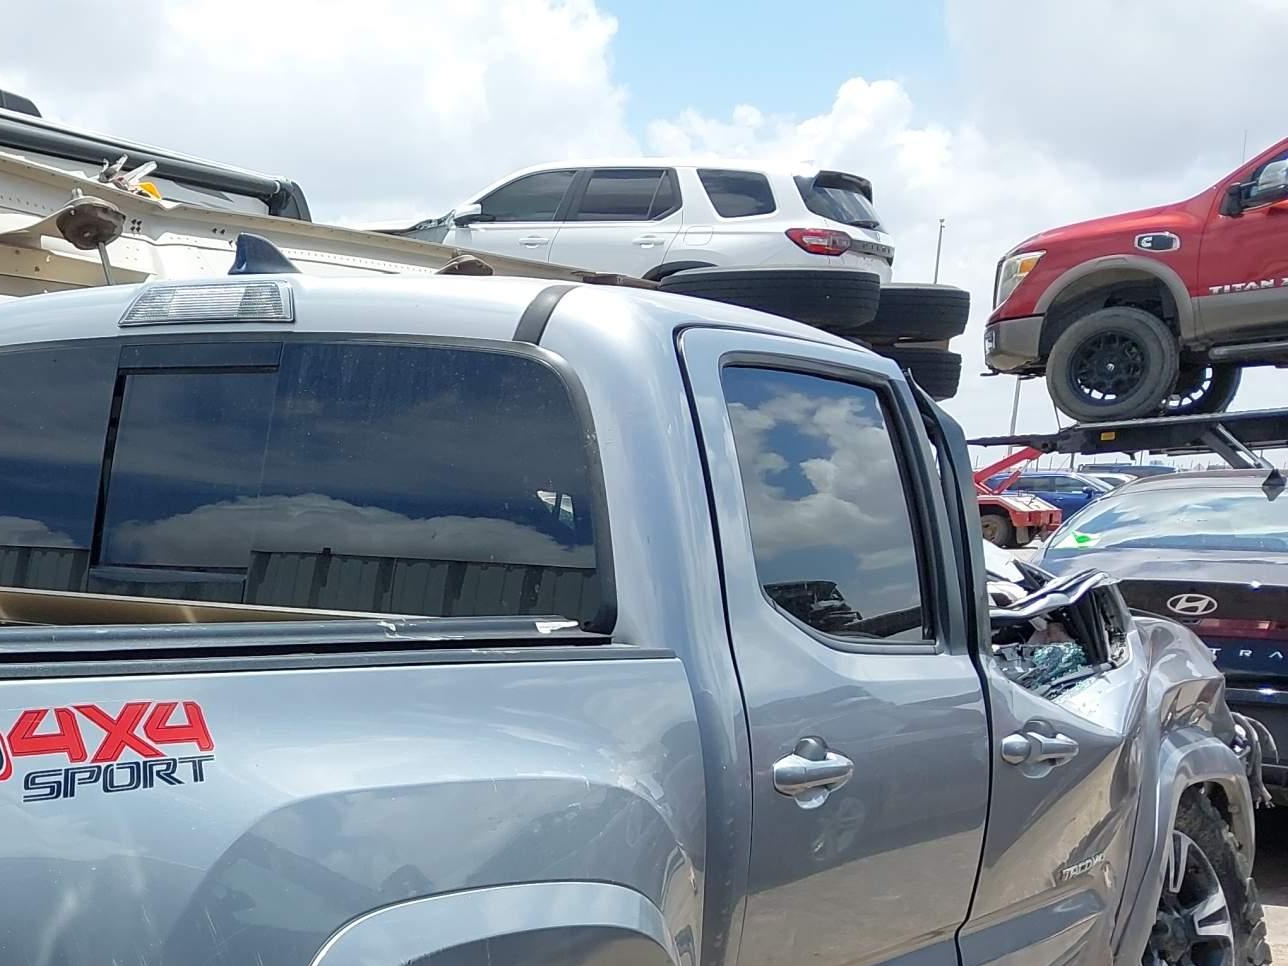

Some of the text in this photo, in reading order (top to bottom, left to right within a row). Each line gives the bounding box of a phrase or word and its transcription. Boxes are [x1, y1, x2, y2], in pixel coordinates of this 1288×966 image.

[1208, 278, 1274, 295] TITAN
[7, 699, 217, 764] 4X4
[22, 754, 216, 803] SPORT
